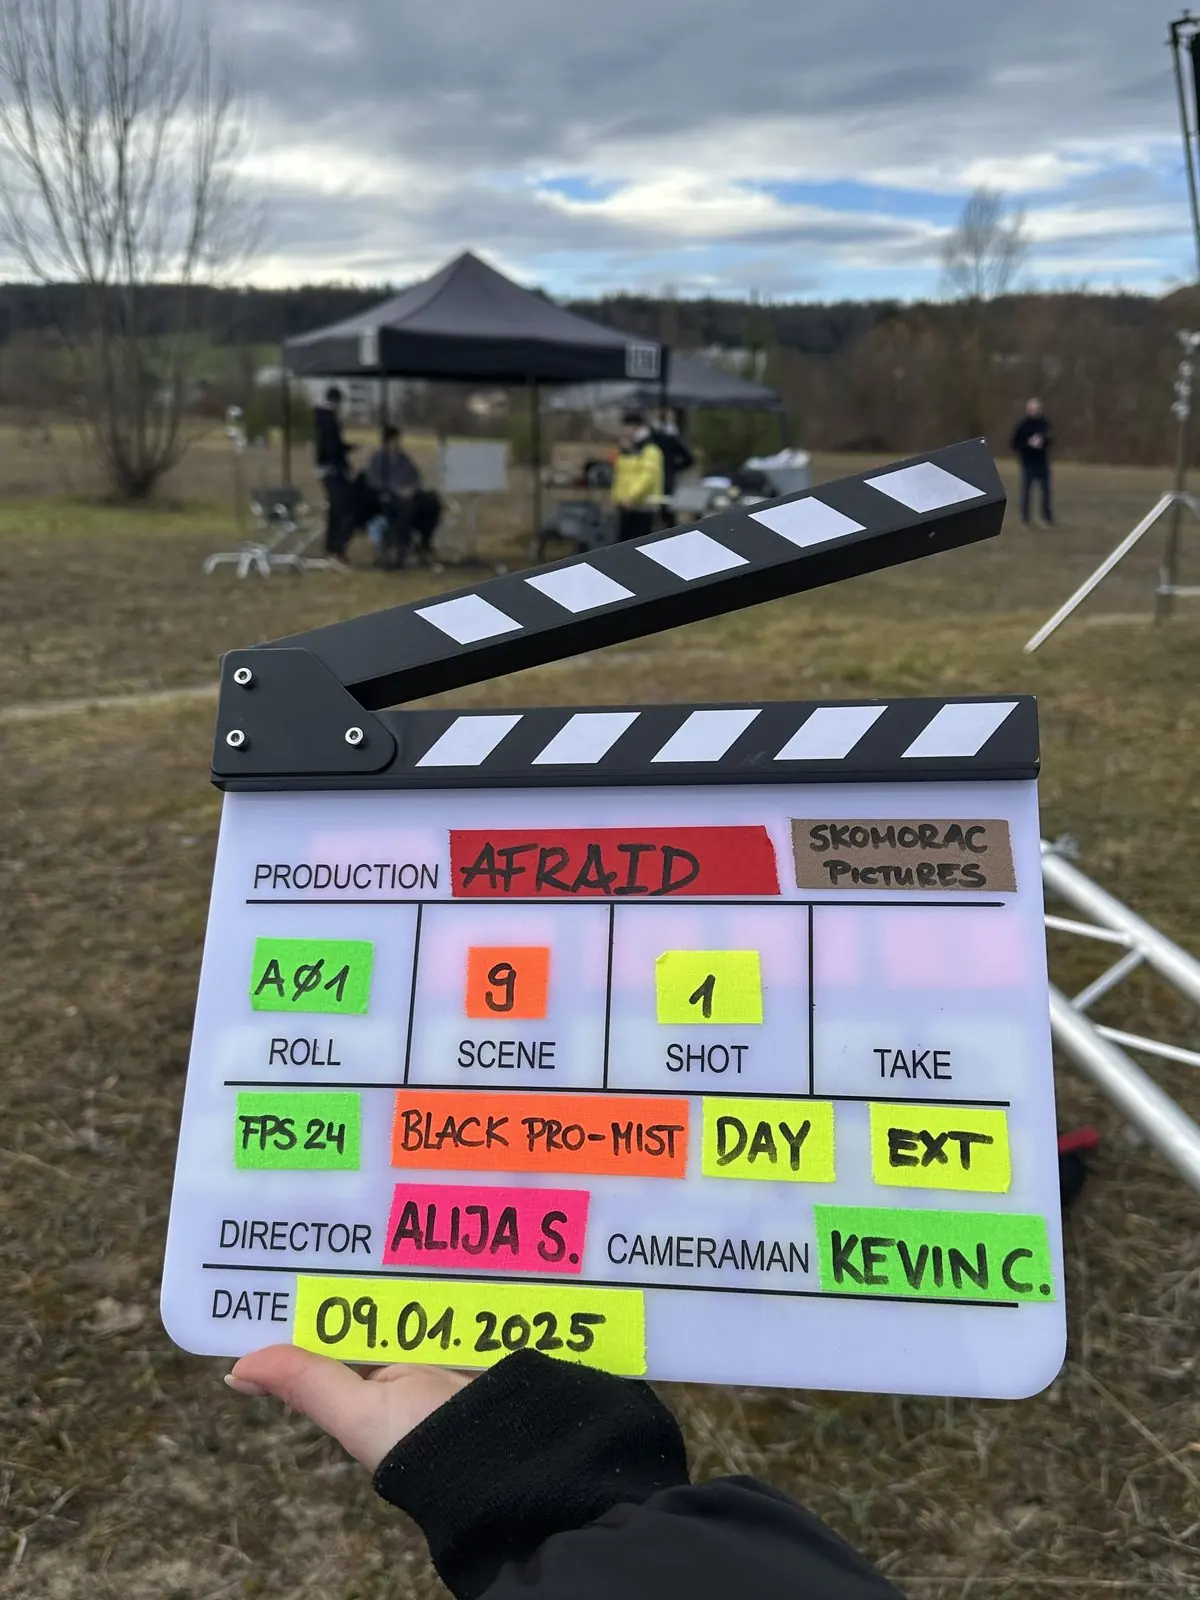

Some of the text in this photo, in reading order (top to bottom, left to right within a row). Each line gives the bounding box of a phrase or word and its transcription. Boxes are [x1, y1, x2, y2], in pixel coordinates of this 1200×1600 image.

[809, 823, 989, 854] SKOMORAC
[253, 863, 439, 889] PRODUCTION
[460, 843, 700, 896] AFRAID
[485, 962, 516, 1012] 9
[688, 974, 715, 1019] 1
[269, 1038, 341, 1066] ROLL
[457, 1040, 556, 1069] SCENE
[666, 1044, 749, 1074] SHOT
[873, 1049, 952, 1080] TAKE
[238, 1114, 345, 1155] FPS 24
[401, 1109, 684, 1159] BLACK PRO-MIST
[715, 1115, 811, 1171] DAY
[887, 1127, 994, 1170] EXT
[220, 1219, 371, 1254] DIRECTOR
[390, 1201, 579, 1265] ALIJA S.
[607, 1233, 809, 1274] CAMERAMAN
[831, 1230, 1051, 1296] KEVIN C.
[212, 1289, 290, 1322] DATE
